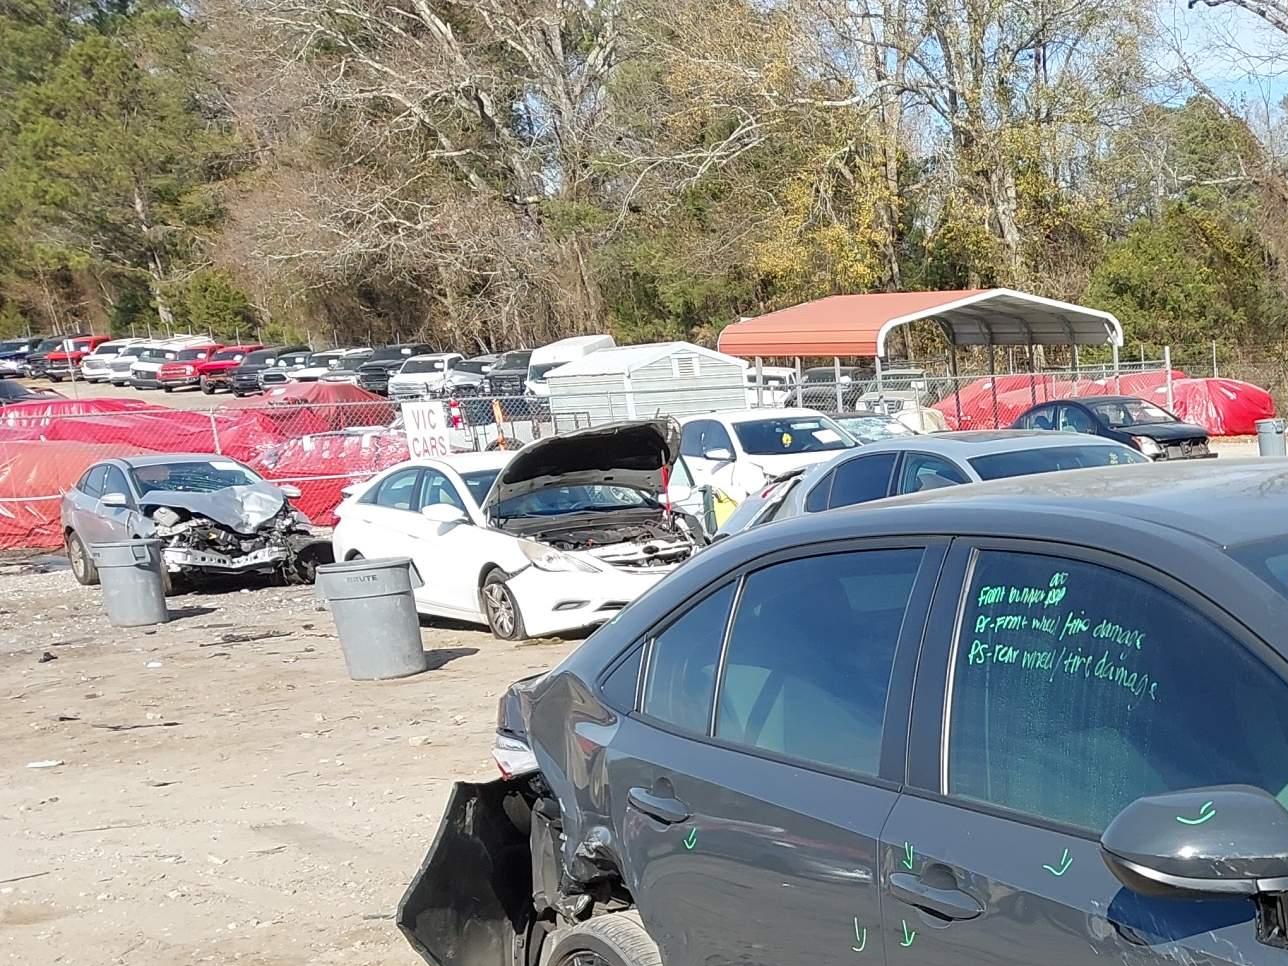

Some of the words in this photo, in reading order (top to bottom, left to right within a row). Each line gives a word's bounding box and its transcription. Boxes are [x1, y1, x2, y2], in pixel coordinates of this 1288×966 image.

[411, 408, 437, 429] VIC
[412, 436, 447, 457] CARS
[346, 574, 377, 583] BRUTE
